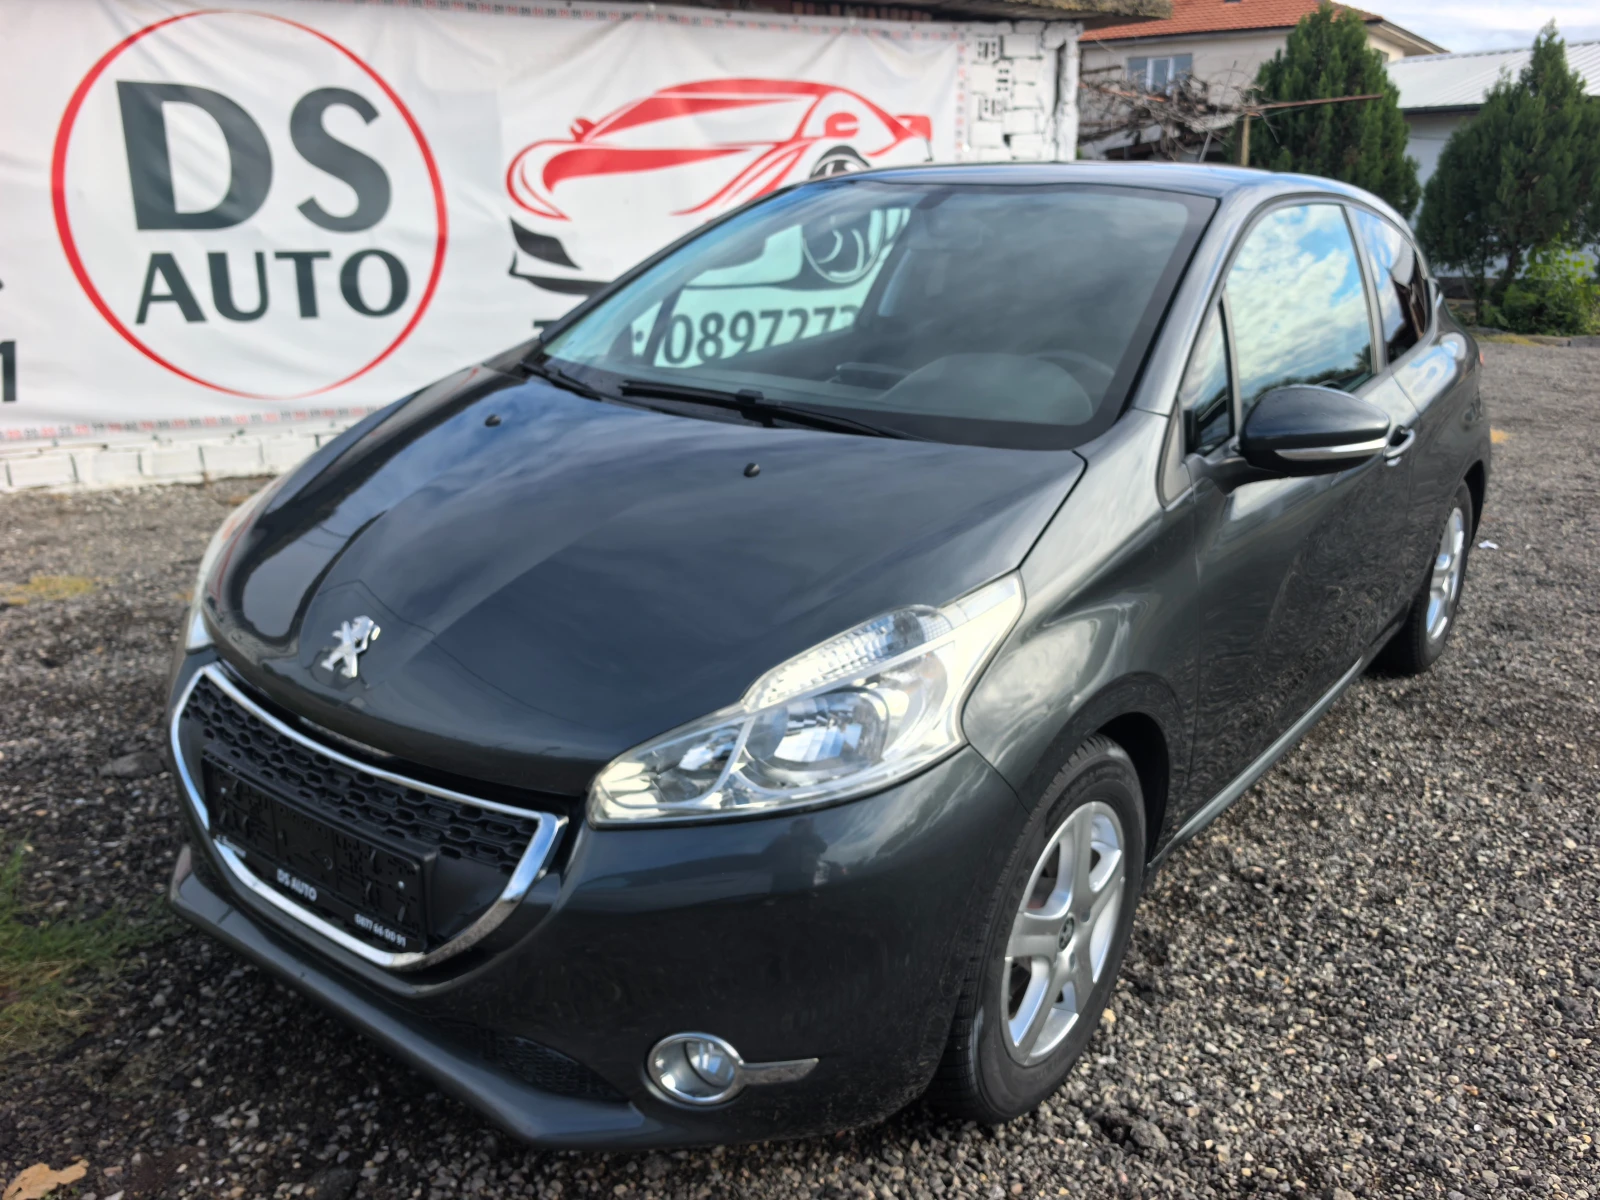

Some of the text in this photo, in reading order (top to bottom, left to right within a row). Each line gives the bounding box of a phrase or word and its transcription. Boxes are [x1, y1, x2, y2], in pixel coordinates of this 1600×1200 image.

[116, 80, 392, 233] DS
[135, 248, 410, 325] AUTO
[277, 868, 317, 901] DS AUTO
